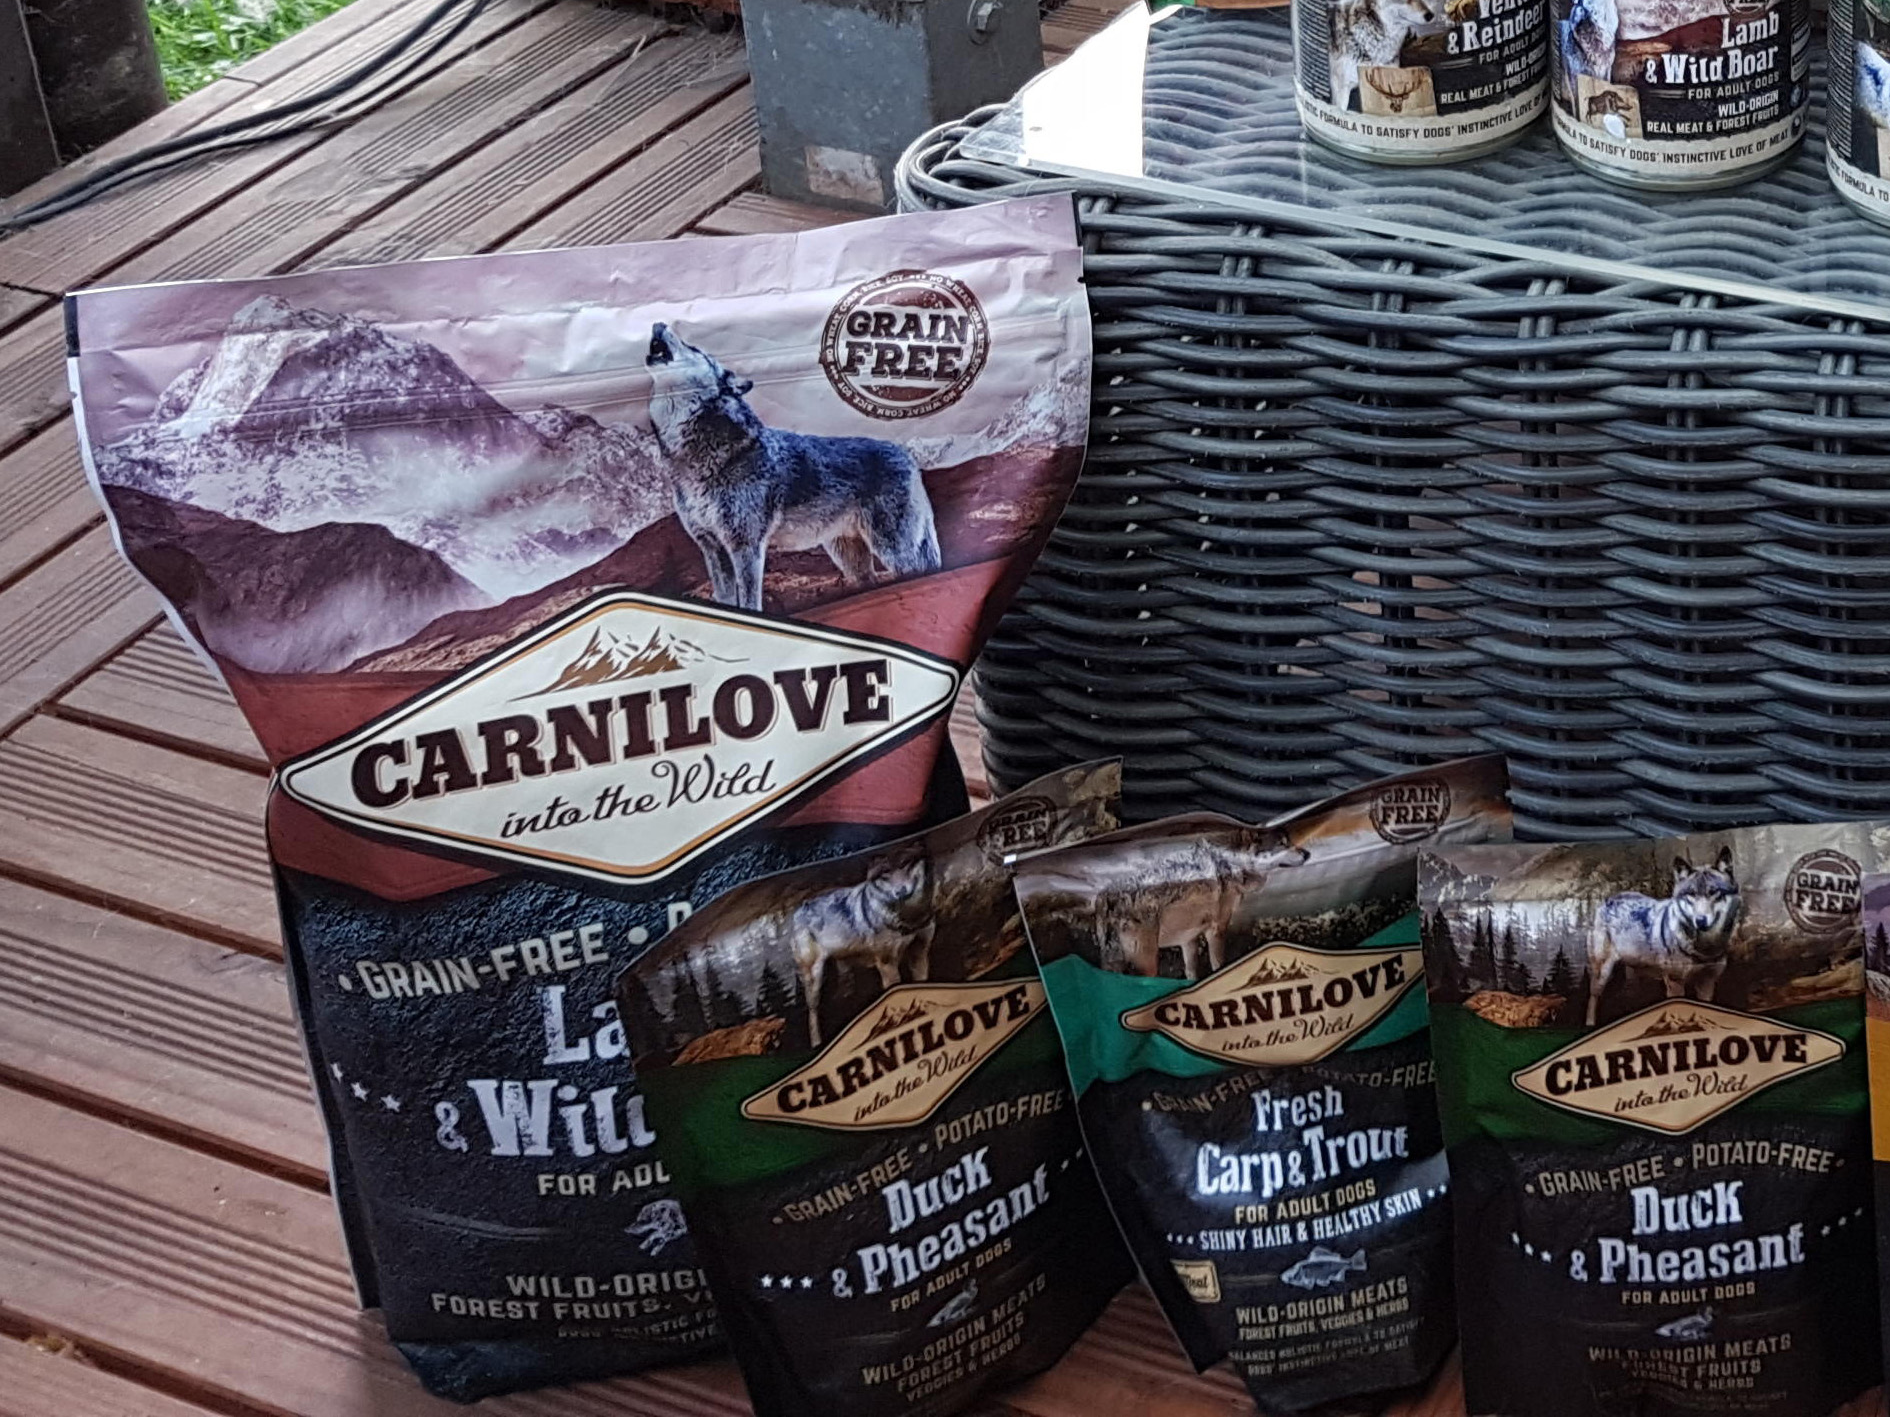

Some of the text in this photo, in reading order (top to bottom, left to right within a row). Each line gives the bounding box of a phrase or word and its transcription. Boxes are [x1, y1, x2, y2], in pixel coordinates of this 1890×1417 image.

[1448, 0, 1545, 54] & Reindeer
[1721, 11, 1780, 49] Lamb
[1645, 46, 1779, 84] & Wild Boar
[1688, 72, 1779, 100] FOR ADULT DOGS
[1441, 84, 1494, 104] REAL MEAT
[1647, 107, 1779, 133] REAL MEAT & FOREST FRUITS
[1718, 90, 1779, 117] WILD-ORIGIN
[846, 310, 970, 344] GRAIN
[841, 341, 964, 381] FREE
[348, 657, 893, 810] CARNILOVE
[499, 754, 776, 842] into the Wild
[1795, 892, 1861, 914] FREE
[1796, 874, 1862, 900] GRAIN
[356, 923, 609, 1001] GRAIN-FREE
[1154, 955, 1407, 1030] CARNILOVE
[776, 984, 1031, 1117] CARNILOVE
[1544, 1033, 1808, 1097] CARNILOVE
[434, 1101, 470, 1154] &
[1251, 1085, 1344, 1134] Fresh
[785, 1088, 1065, 1223] GRAIN-FREE POTATO-FREE
[1196, 1125, 1410, 1199] Carp & Trout
[1539, 1140, 1834, 1197] GRAIN-FREE POTATO-FREE
[538, 1173, 596, 1196] FOR
[881, 1146, 993, 1234] Duck
[1234, 1179, 1377, 1226] FOR ADULT DOGS
[1631, 1181, 1744, 1236] Duck
[831, 1166, 1052, 1299] & Pheasant
[1200, 1188, 1423, 1251] SHINY HAIR & HEALTHY SKIN
[890, 1239, 1013, 1313] FOR ADULT DOGS
[1569, 1224, 1806, 1283] & Pheasant
[431, 1293, 539, 1320] FOREST
[1621, 1282, 1756, 1306] FOR ADULT DOGS
